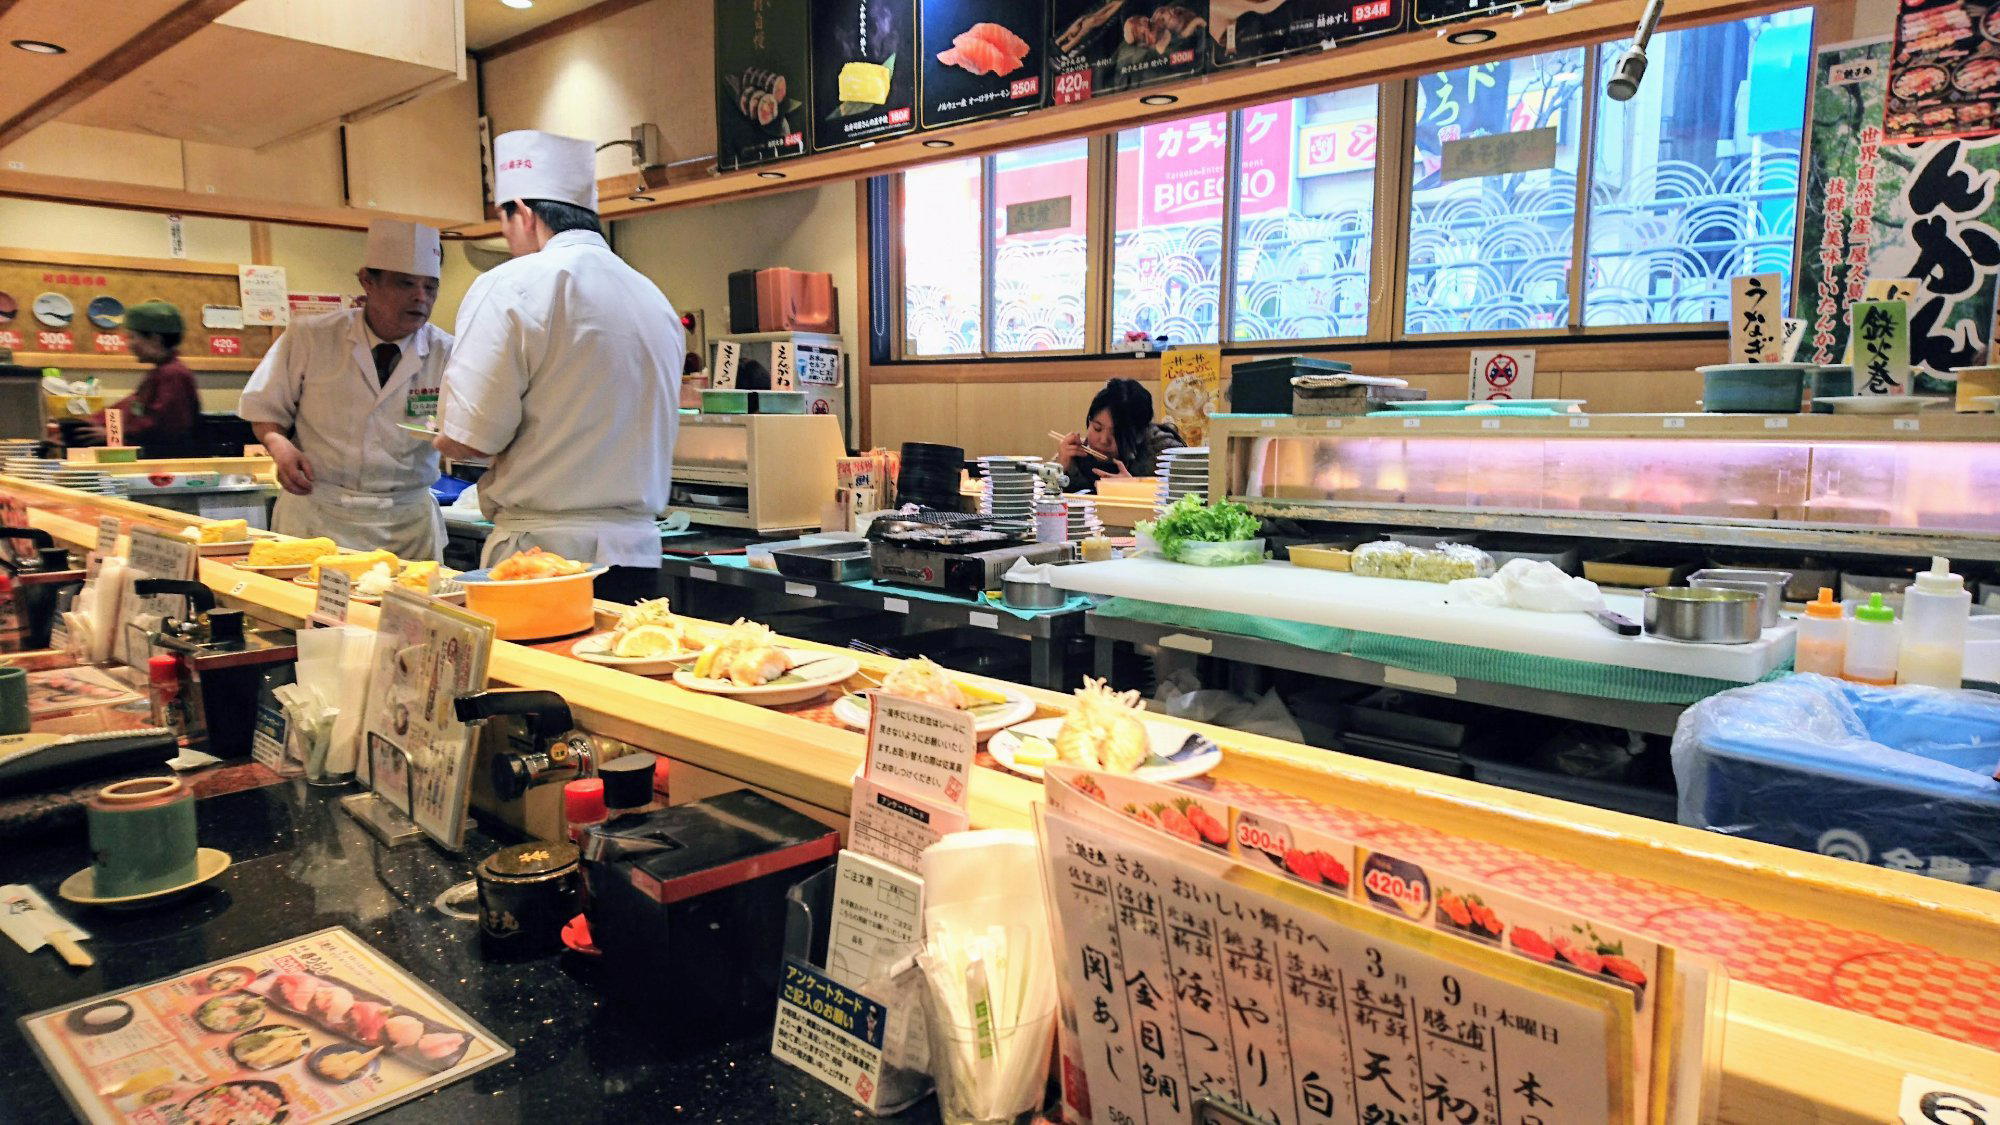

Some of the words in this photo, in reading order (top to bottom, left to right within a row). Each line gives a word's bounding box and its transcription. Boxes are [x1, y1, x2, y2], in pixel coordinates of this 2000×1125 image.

[1154, 180, 1200, 212] BIG
[1812, 178, 1847, 364] 抜群に美味しいたんかん
[1906, 140, 2000, 372] んかん
[1860, 305, 1901, 394] 鉄火巻
[843, 867, 874, 889] ご注文票
[1172, 933, 1213, 961] 新鮮
[1172, 876, 1330, 953] おいしい舞台へ
[1497, 1008, 1560, 1045] 木曜日
[1224, 927, 1266, 961] 銚子
[1227, 956, 1274, 987] 新鮮
[1286, 951, 1334, 984] 茨城
[784, 985, 854, 1030] ご記入のお願い
[786, 964, 863, 1013] アンケートカード
[1288, 982, 1340, 1017] 新鮮
[1351, 979, 1407, 1019] 長崎
[1125, 969, 1181, 1113] 金目鯛
[1354, 1006, 1411, 1046] 新鮮
[1423, 1006, 1487, 1050] 勝浦
